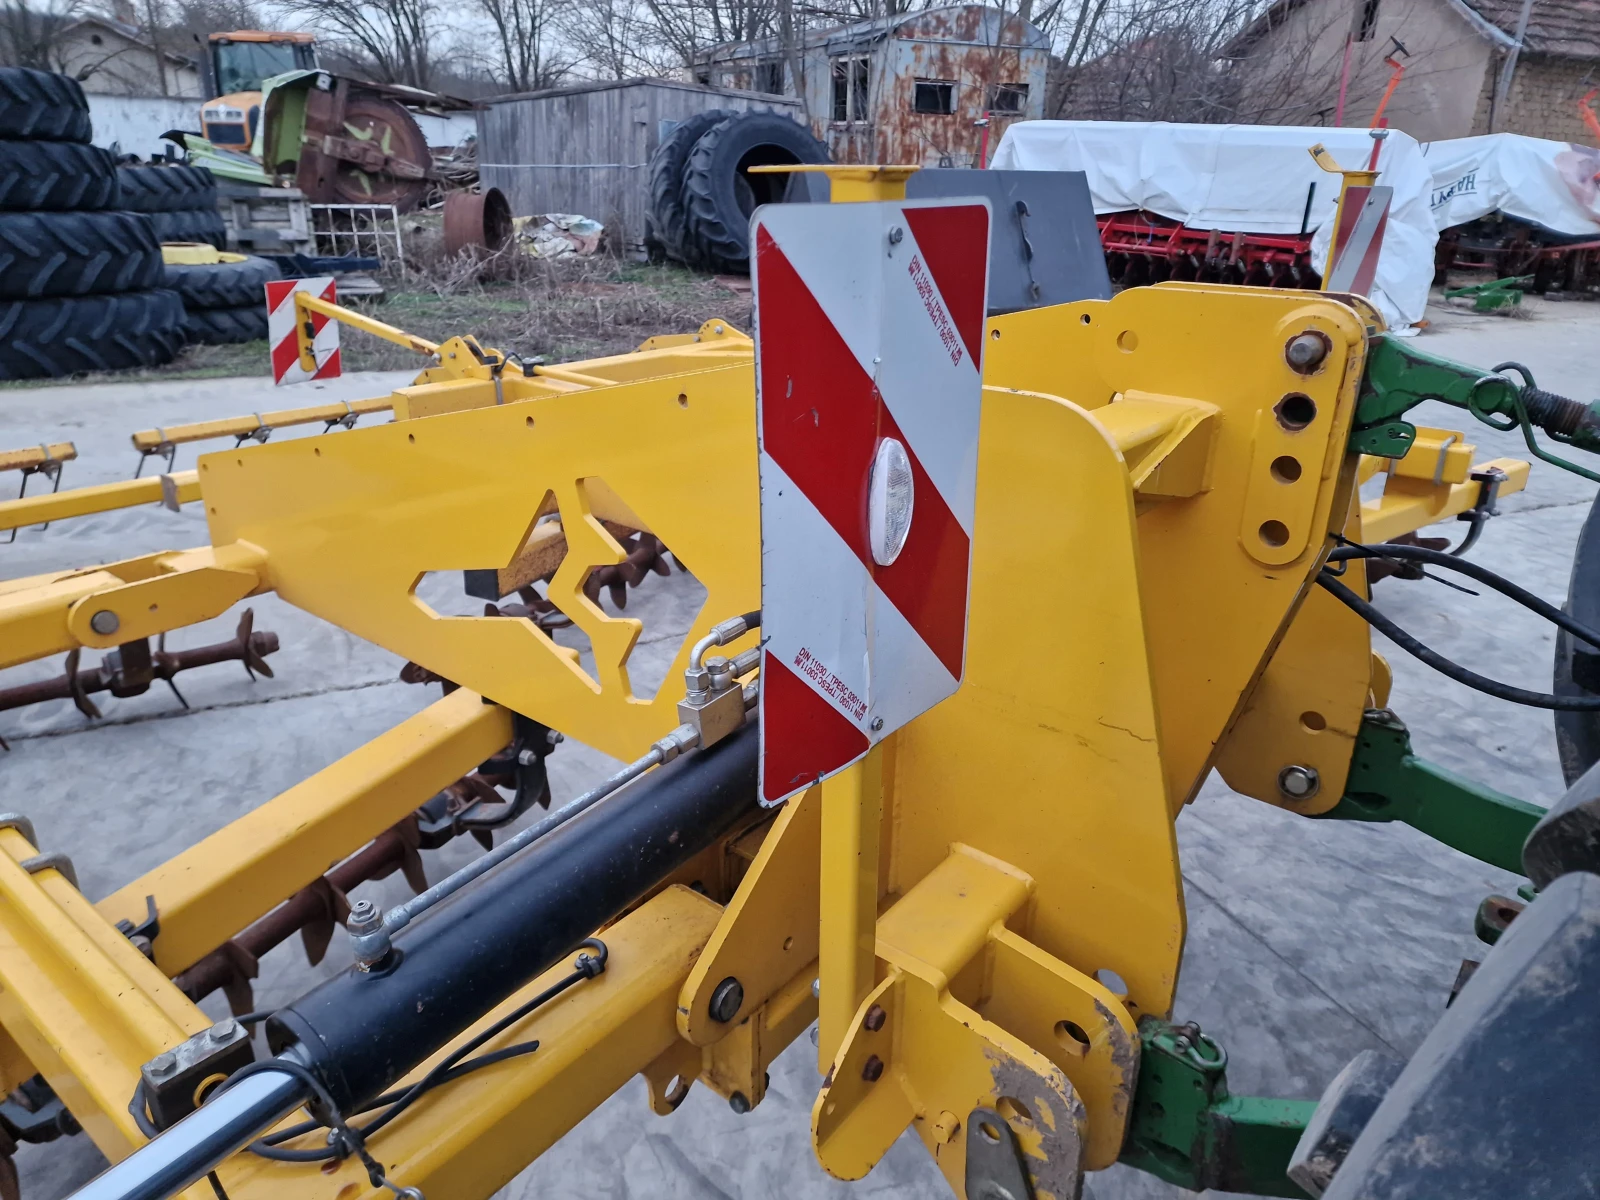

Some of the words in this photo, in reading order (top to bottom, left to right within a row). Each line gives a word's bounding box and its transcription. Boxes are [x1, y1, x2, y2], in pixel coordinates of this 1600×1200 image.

[799, 647, 811, 662] DIN
[811, 658, 827, 676] 11030
[830, 675, 848, 695] TPESC
[818, 677, 836, 697] TPESC
[839, 696, 854, 712] 11030
[854, 709, 864, 721] DIN
